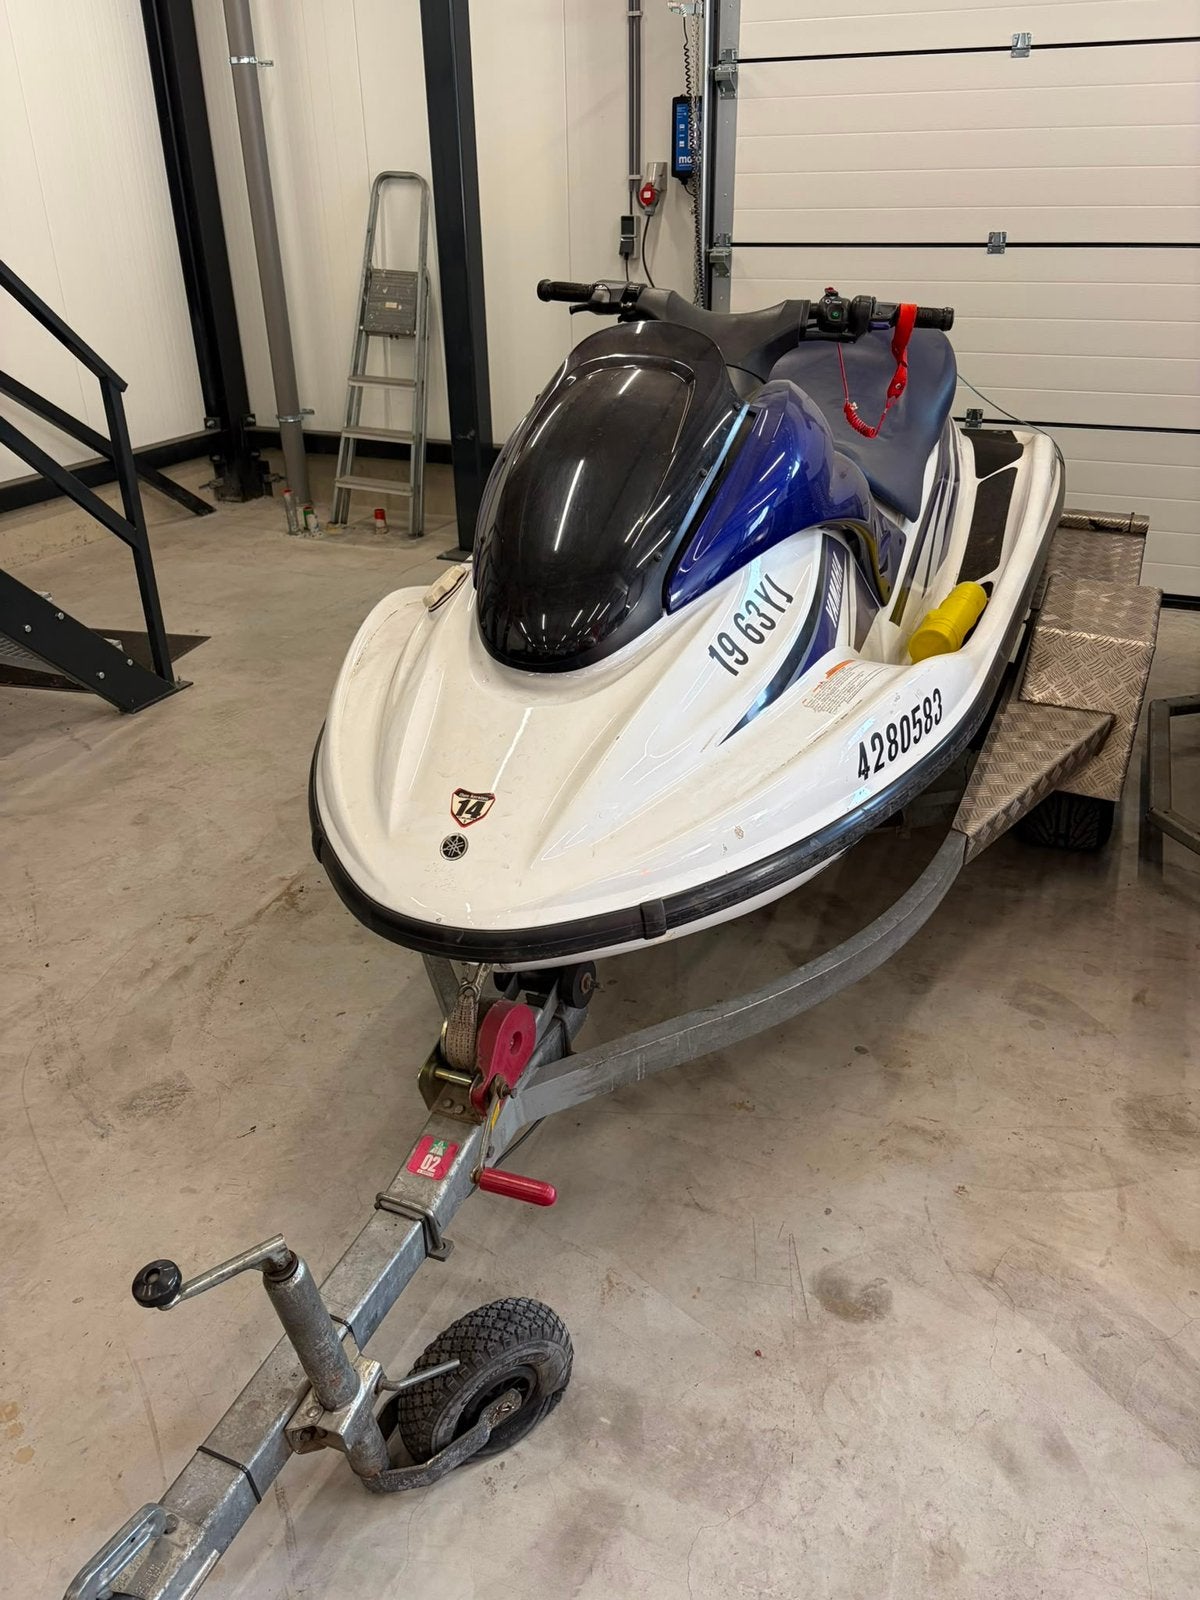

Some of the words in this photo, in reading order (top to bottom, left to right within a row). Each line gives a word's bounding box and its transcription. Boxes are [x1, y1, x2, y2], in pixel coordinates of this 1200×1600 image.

[707, 632, 749, 677] 19
[858, 688, 942, 780] 4280583
[455, 799, 486, 819] 14
[420, 1153, 442, 1173] 02
